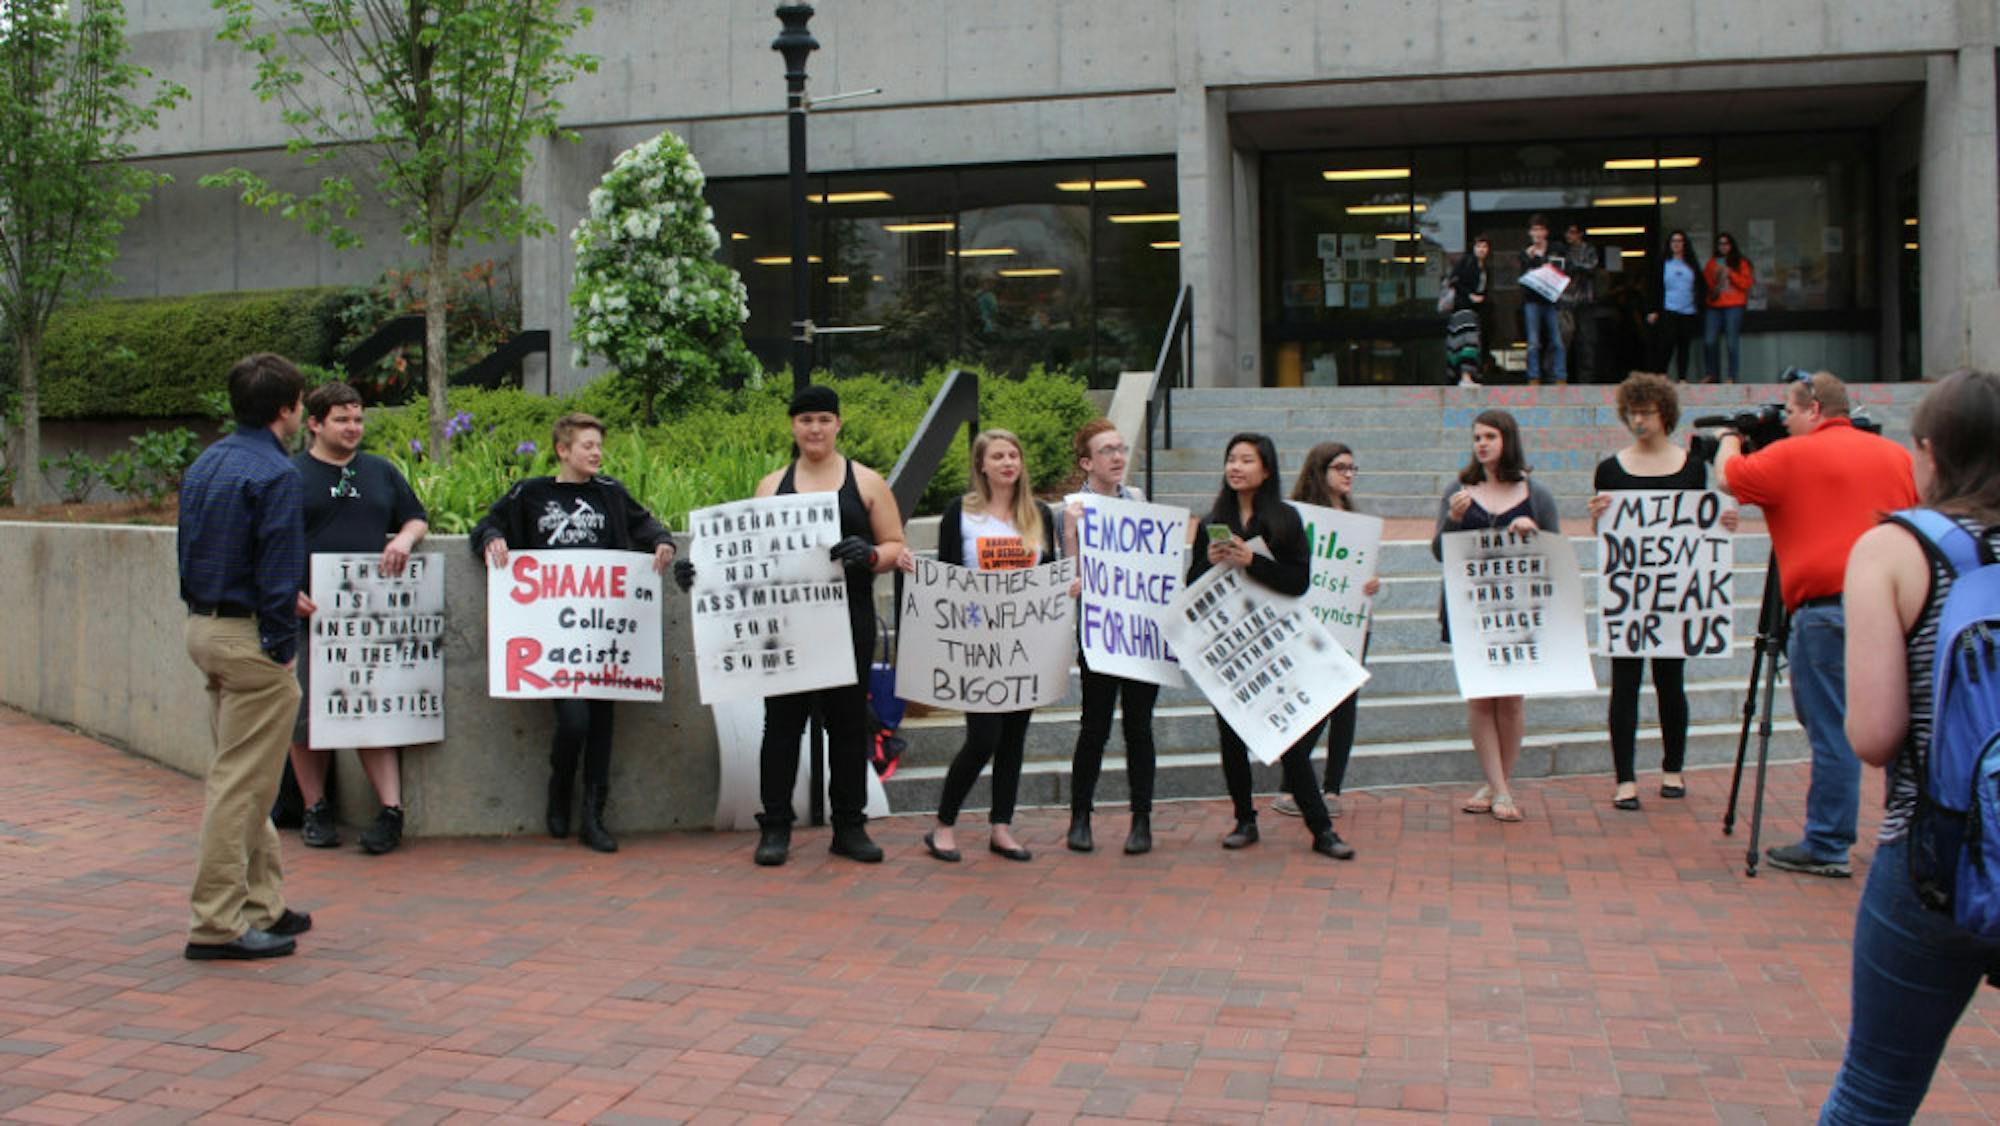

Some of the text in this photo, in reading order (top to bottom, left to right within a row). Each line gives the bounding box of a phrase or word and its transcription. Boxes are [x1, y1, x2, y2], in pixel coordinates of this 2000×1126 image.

[700, 507, 834, 537] LIBERATION
[1613, 491, 1720, 530] MILO
[716, 534, 810, 558] FOR ALL
[1481, 531, 1531, 548] HATE
[1603, 532, 1728, 575] DOESN'T
[341, 563, 417, 581] THE
[510, 554, 653, 604] SHAME on
[726, 562, 769, 582] NOT
[915, 560, 1071, 594] I'D RATHER BE
[1083, 555, 1176, 605] NO PLACE
[1466, 559, 1540, 577] SPEECH
[1312, 570, 1350, 593] cist
[1478, 584, 1553, 601] HAS NO
[1603, 569, 1732, 616] SPEAK
[336, 593, 411, 608] IS NO
[906, 592, 918, 617] A
[1185, 574, 1239, 623] EMORY
[559, 607, 638, 634] College
[734, 619, 779, 639] FOR
[1085, 604, 1133, 657] FOR
[1209, 611, 1230, 632] IS
[1483, 612, 1542, 630] PLACE
[1205, 606, 1276, 668] NOTHING
[1607, 614, 1730, 657] FOR US
[328, 648, 347, 663] IN
[362, 647, 391, 663] THE
[723, 650, 795, 672] SOME
[939, 639, 1028, 669] THAN A
[1221, 621, 1297, 683] WITHOUT
[1489, 646, 1539, 664] HERE
[351, 670, 374, 685] OF
[933, 668, 1038, 706] BIGOT!
[1236, 655, 1293, 704] WOMEN
[328, 696, 439, 714] INJUSTICE
